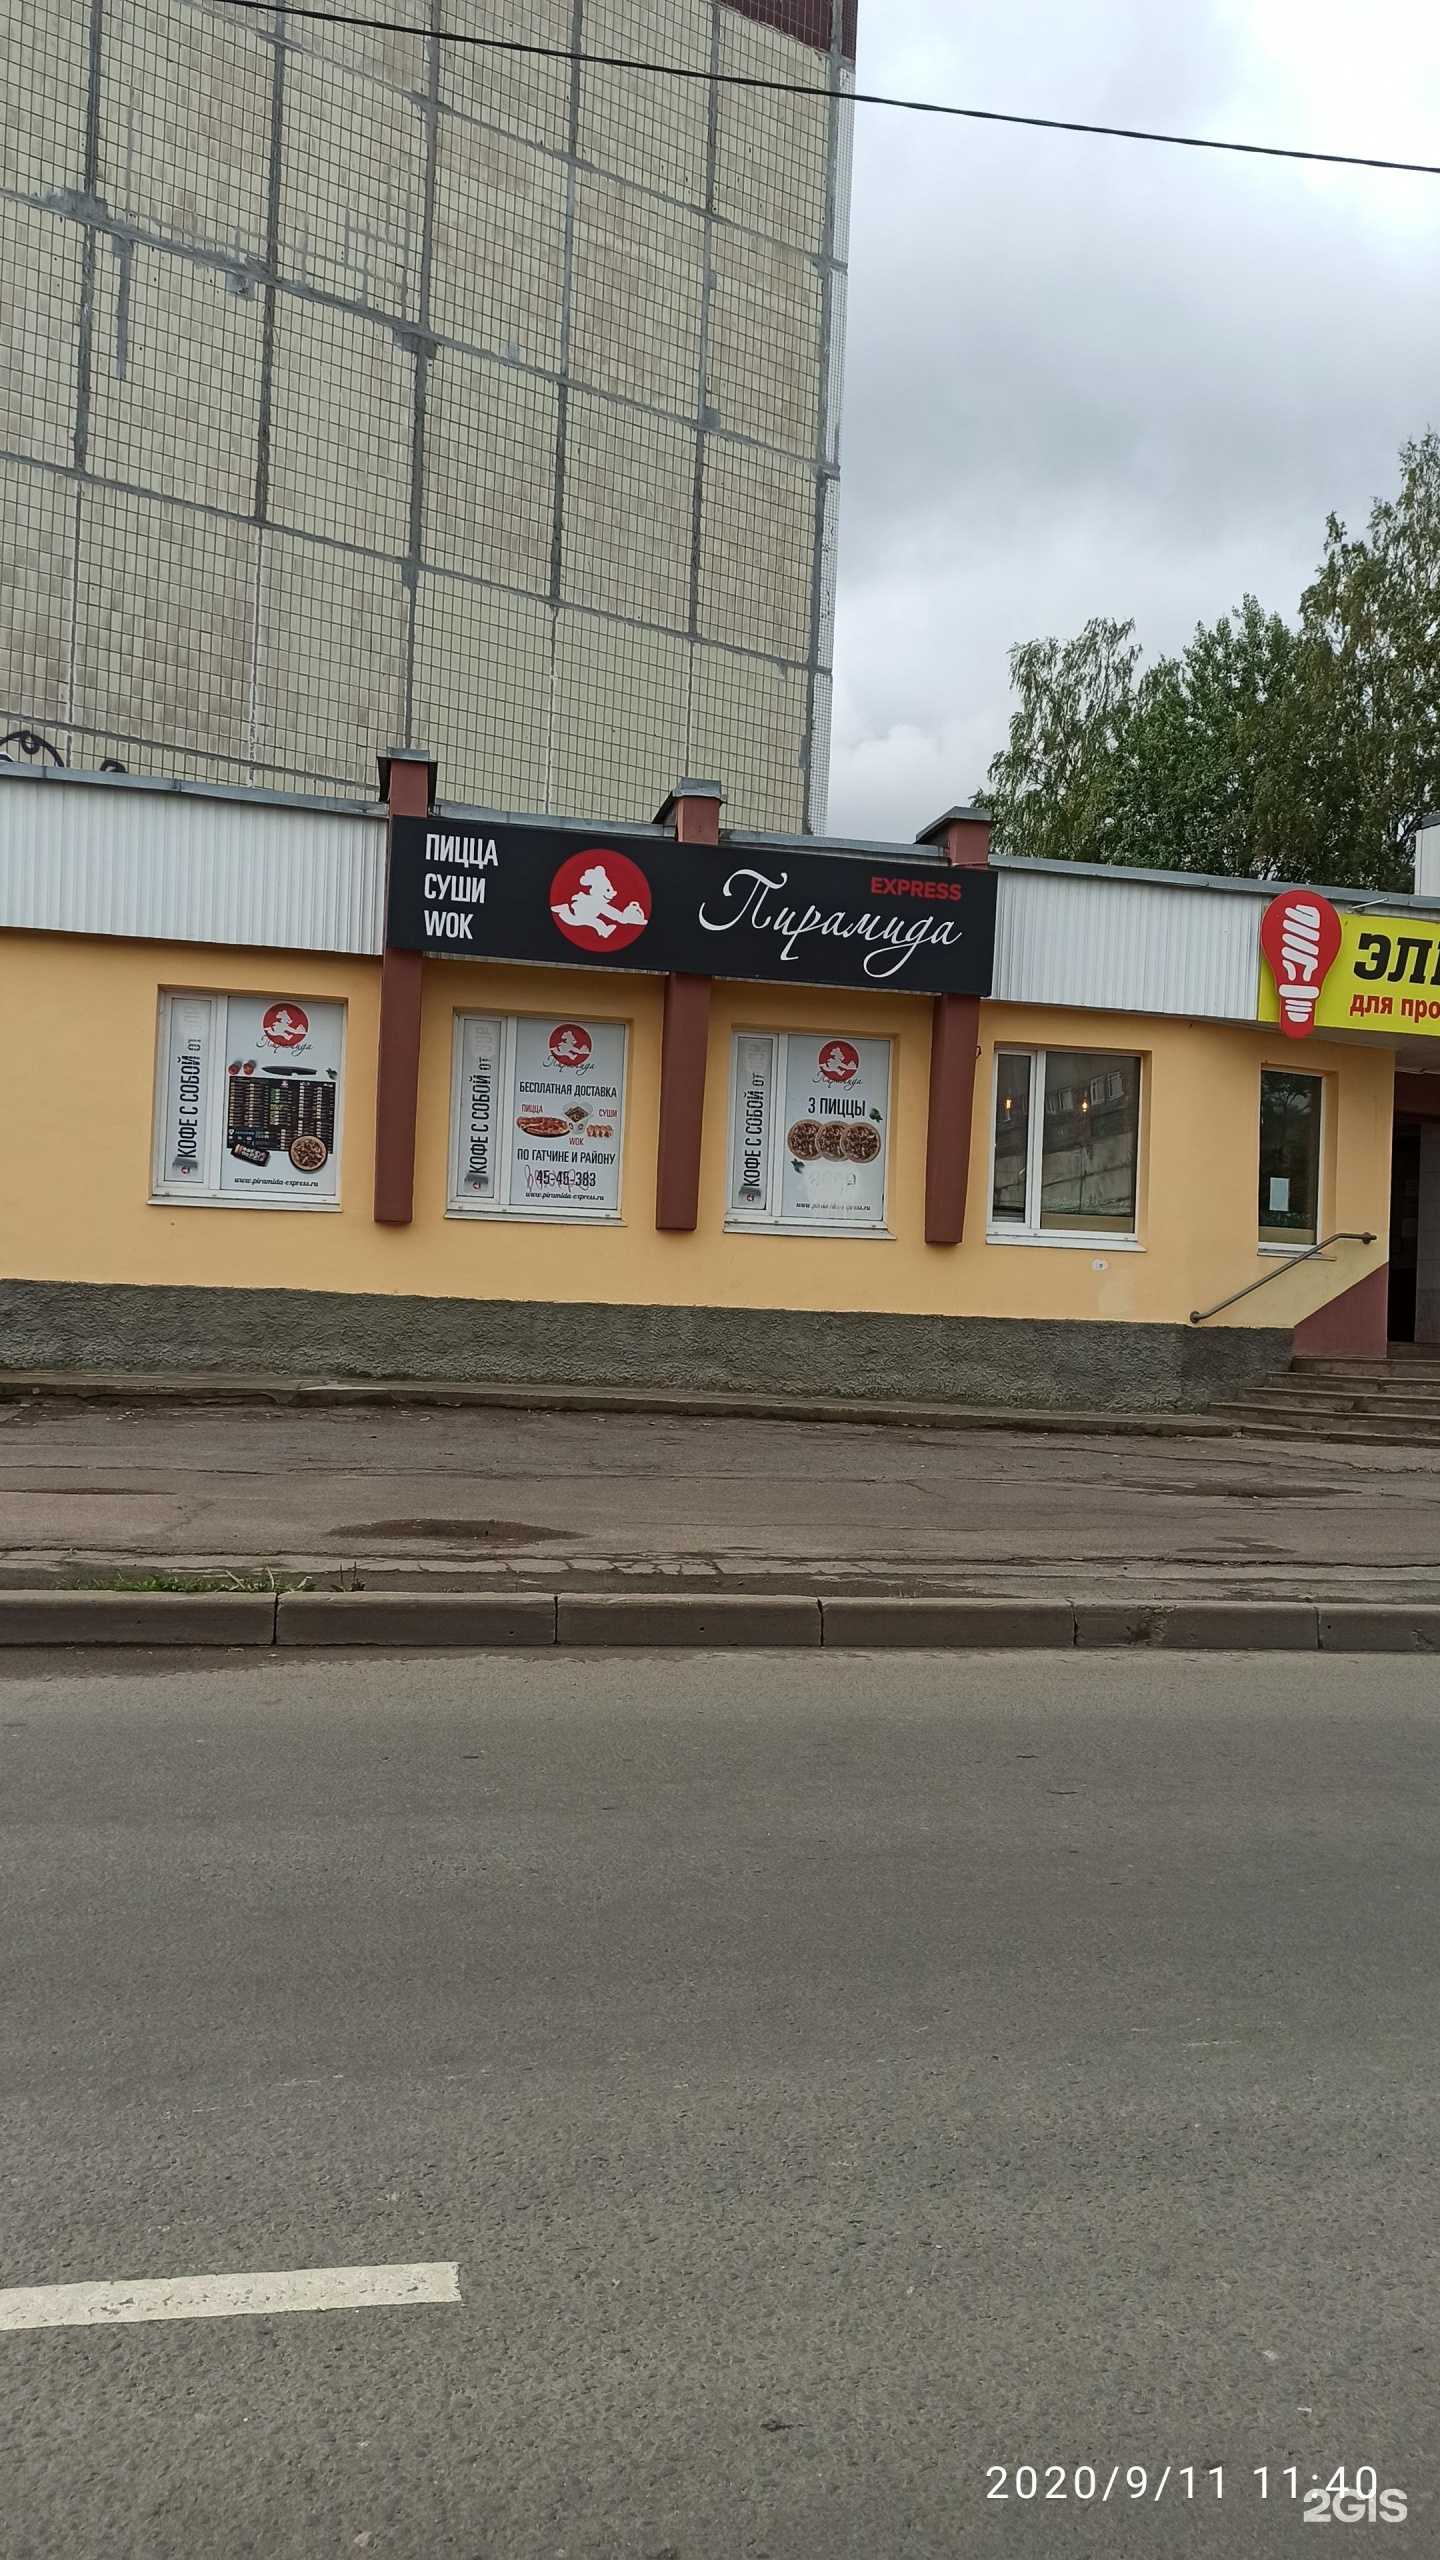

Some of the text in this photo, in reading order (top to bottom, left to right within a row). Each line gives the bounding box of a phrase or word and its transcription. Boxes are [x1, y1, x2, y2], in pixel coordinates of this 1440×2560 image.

[425, 833, 498, 870] ПИЦЦА
[424, 873, 486, 905] СУШИ
[871, 876, 962, 901] EXPRESS
[424, 910, 474, 940] WOK
[698, 868, 964, 978] Пирамида
[1353, 932, 1440, 986] ЭЛ
[1350, 994, 1440, 1023] для про
[256, 1034, 313, 1057] Пирида
[479, 1057, 492, 1071] от
[542, 1054, 595, 1076] Пирида
[177, 1055, 201, 1102] СОБОЙ
[519, 1081, 617, 1098] БЕСПЛАТНАЯ ДОСТАВКА
[752, 1073, 765, 1087] от
[469, 1075, 491, 1120] СОБОЙ
[808, 1097, 866, 1119] 3 ПИЦЦЫ
[179, 1105, 198, 1116] С
[522, 1104, 544, 1114] ПИЦЦА
[598, 1108, 618, 1118] СУШИ
[743, 1091, 764, 1134] СОБОЙ
[176, 1118, 198, 1159] КОФЕ
[471, 1123, 489, 1133] С
[569, 1137, 584, 1146] WOK
[745, 1138, 762, 1147] С
[469, 1135, 489, 1174] КОФЕ
[517, 1148, 616, 1165] ПО ГАТЧИНЕ И РАЙОНУ
[743, 1150, 761, 1187] КОФЕ
[234, 1177, 319, 1188] www.piramida-express.ru
[525, 1192, 605, 1201] www.piramida-express.ru
